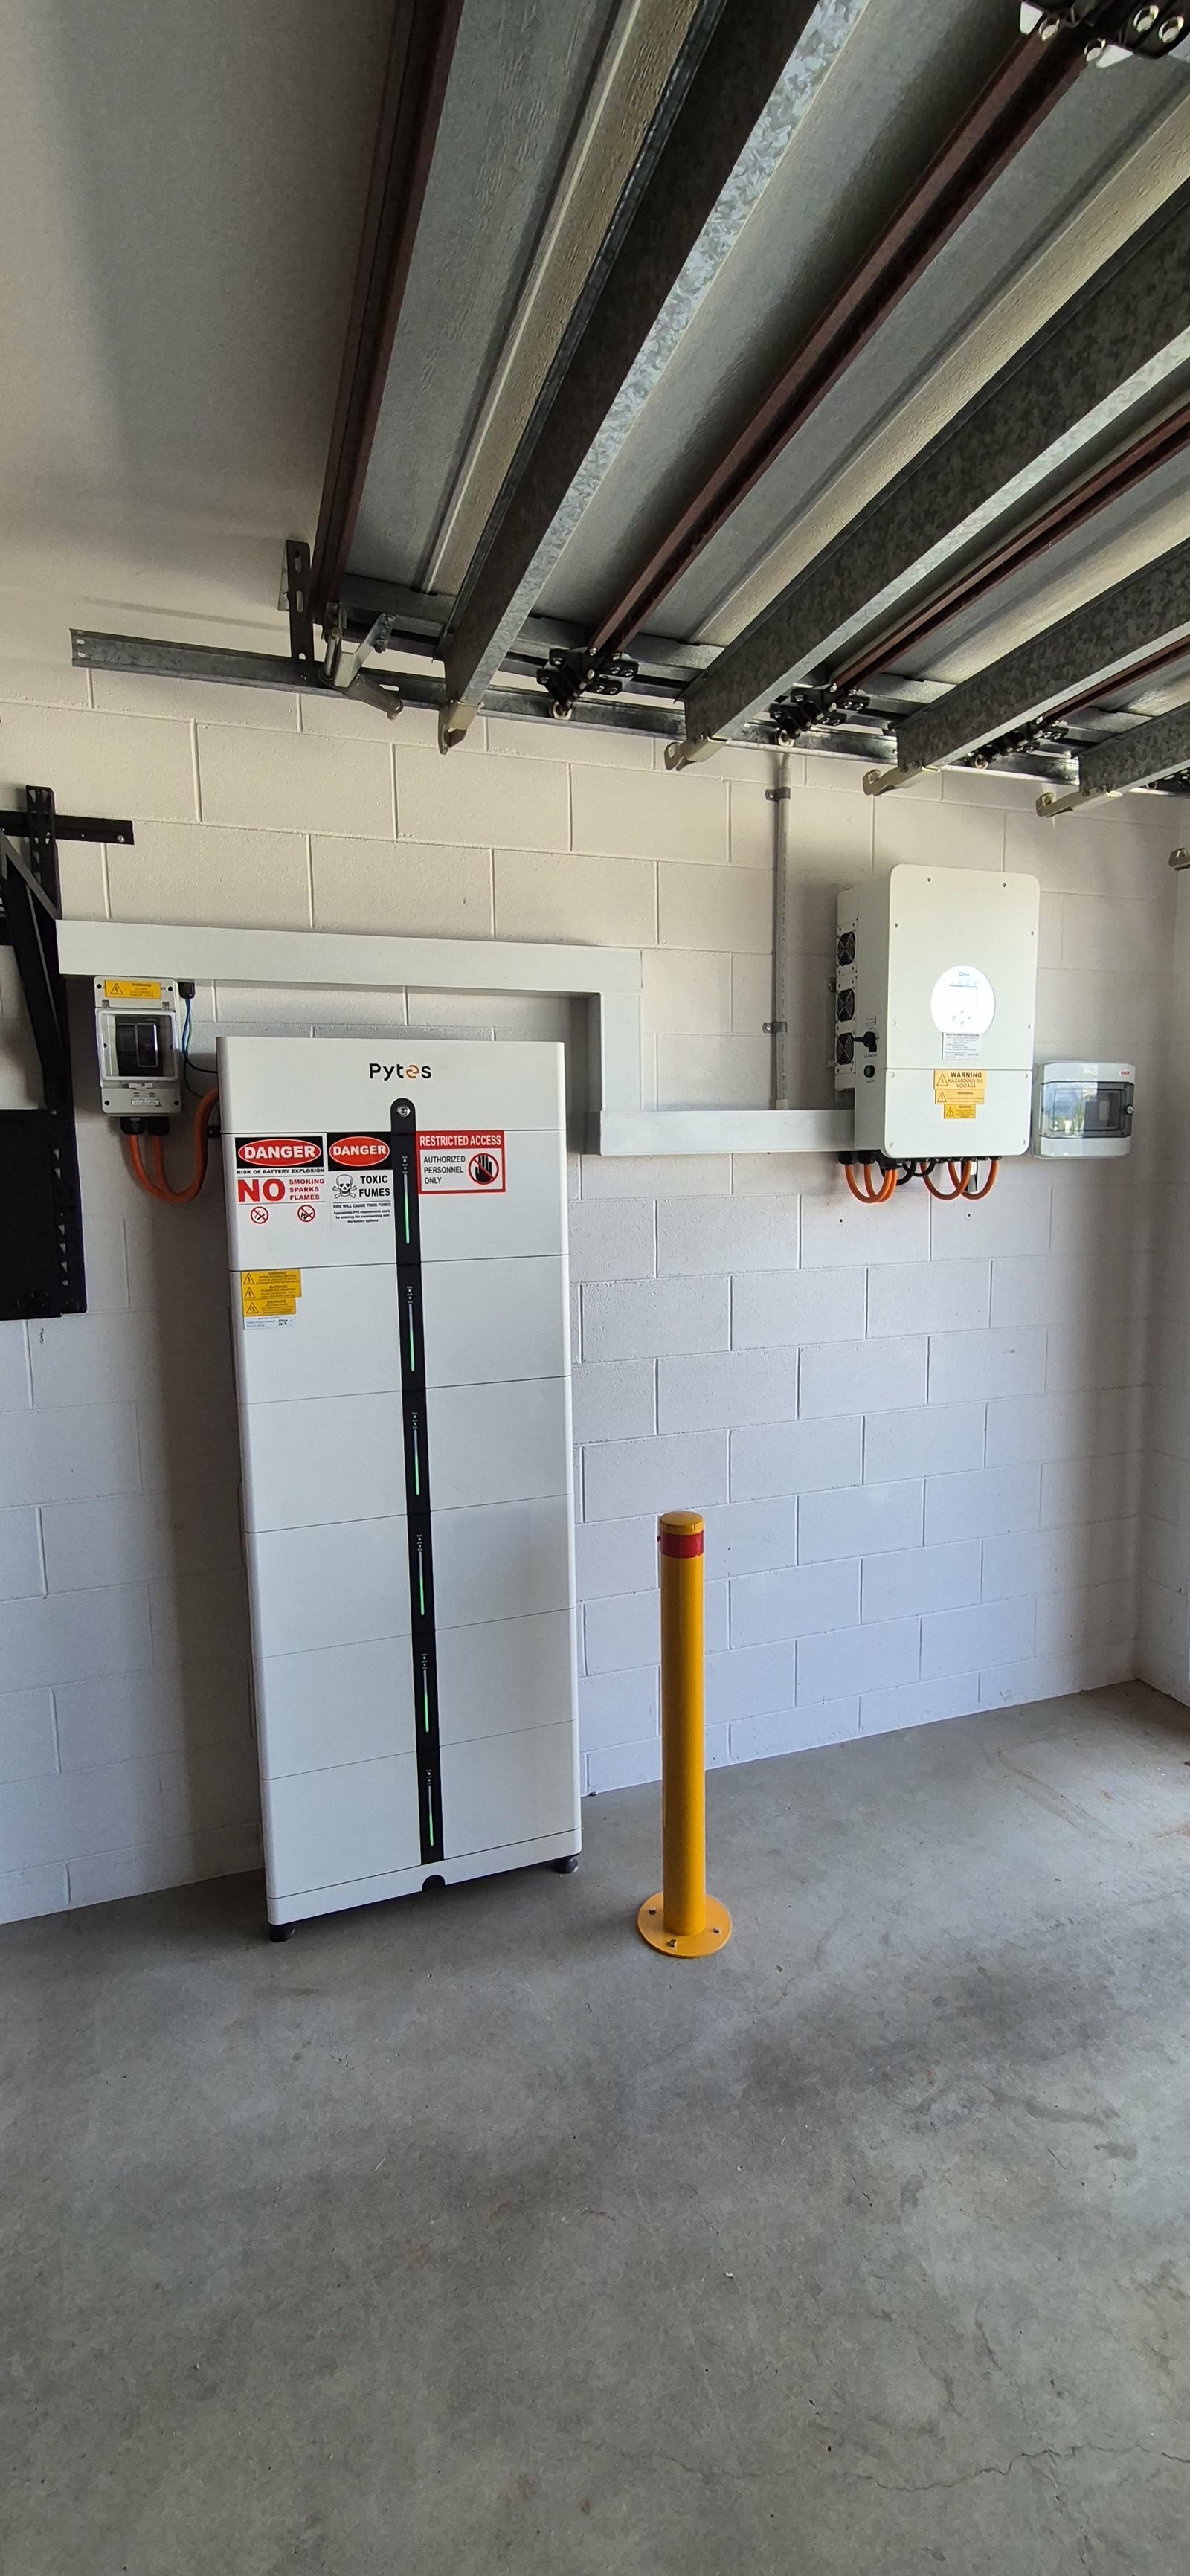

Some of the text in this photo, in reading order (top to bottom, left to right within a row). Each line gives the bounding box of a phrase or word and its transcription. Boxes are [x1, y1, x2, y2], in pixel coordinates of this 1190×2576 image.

[369, 1063, 432, 1081] Pytes
[419, 1135, 501, 1146] RESTRICTED ACCESS
[244, 1145, 316, 1159] DANGER
[332, 1145, 387, 1156] DANGER
[360, 1175, 387, 1184] TOXIC
[237, 1178, 286, 1202] NO
[358, 1188, 390, 1197] FUMES
